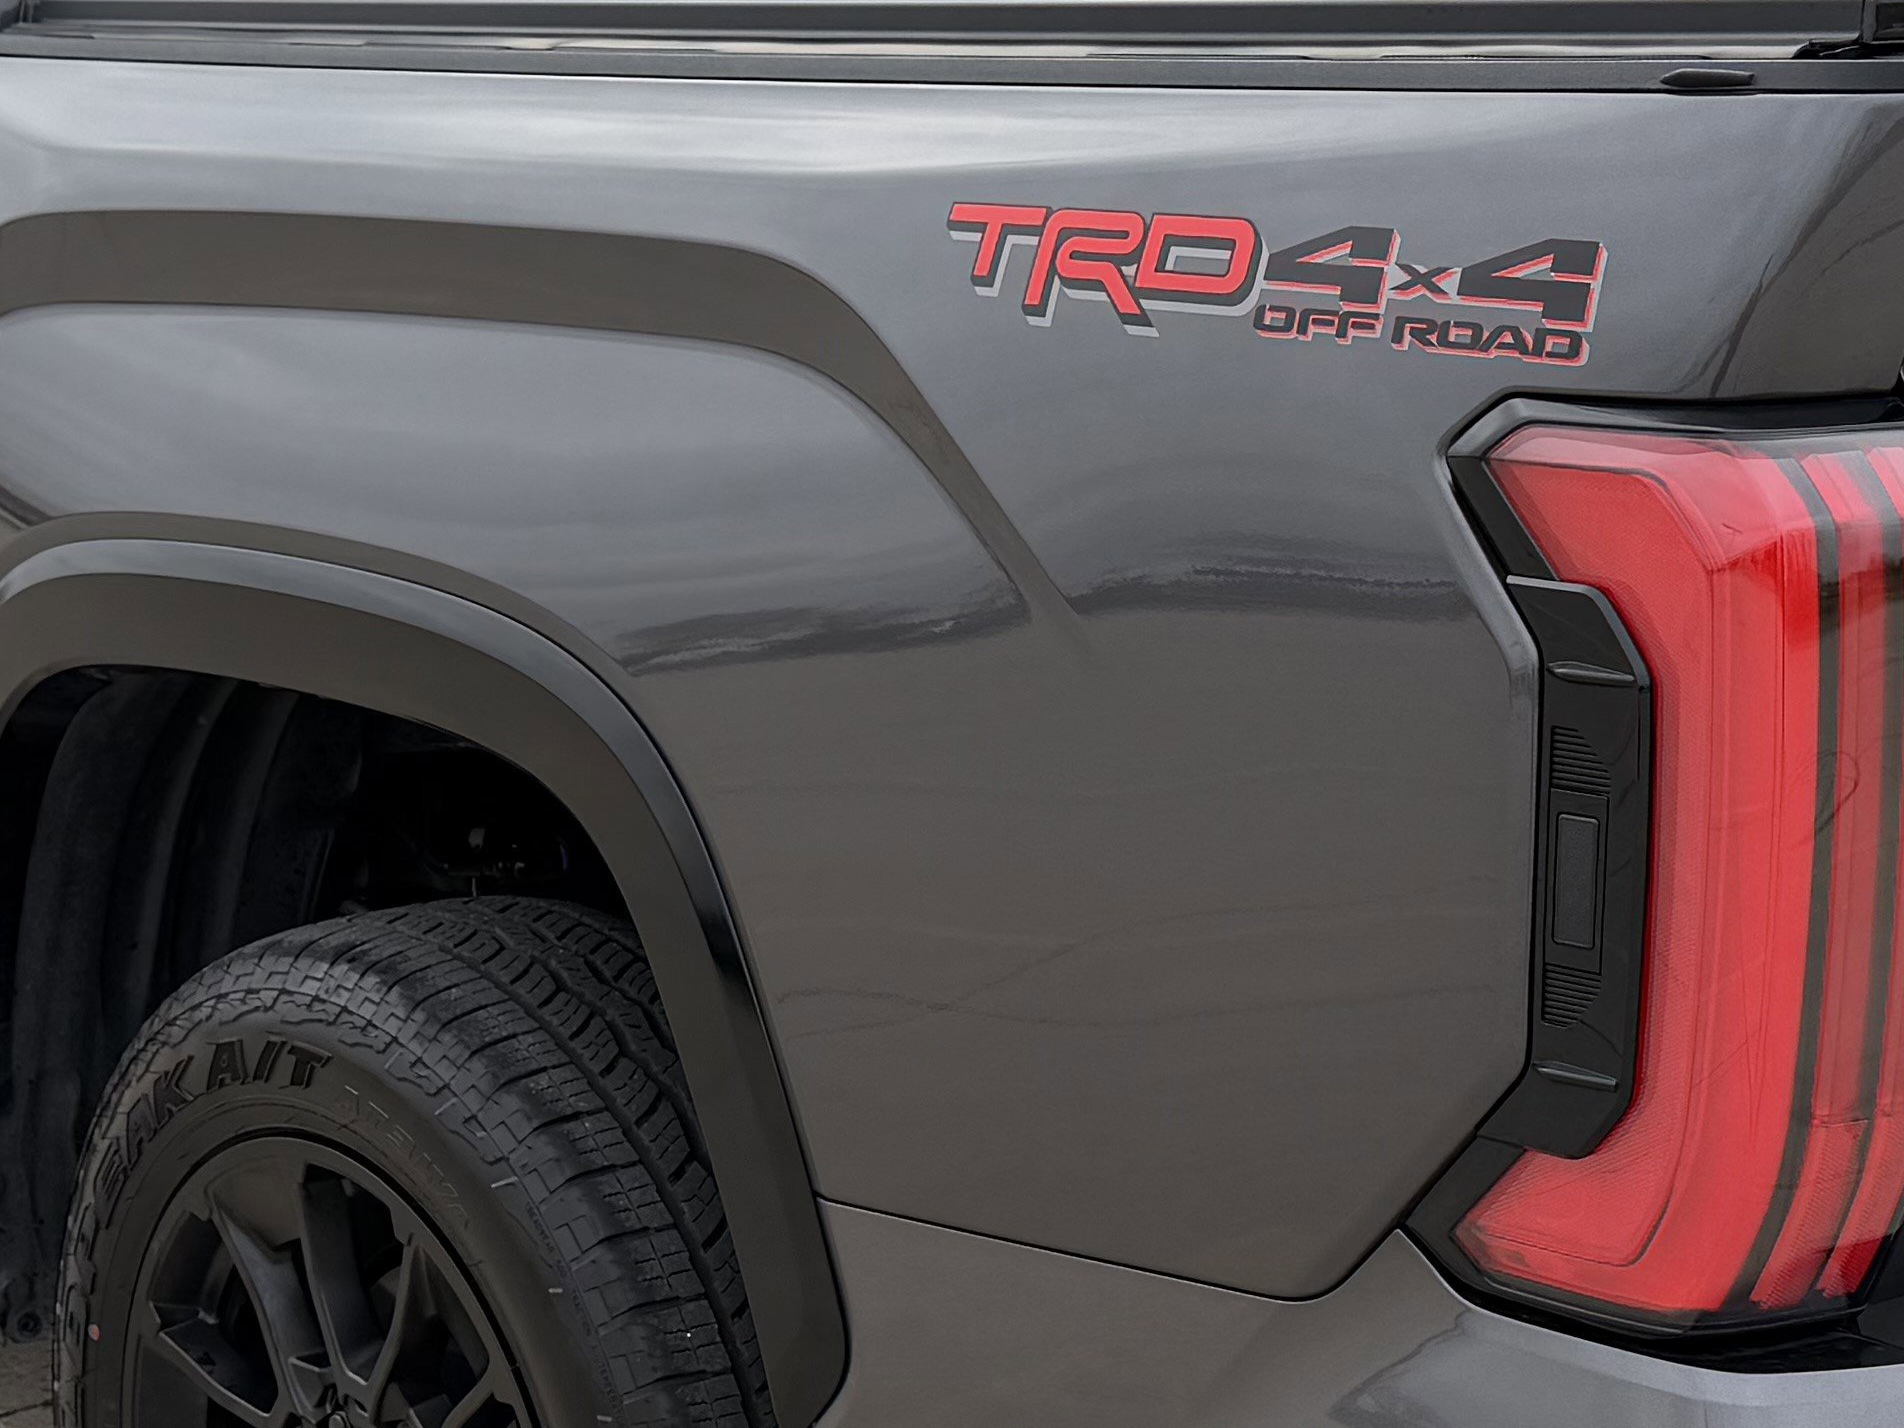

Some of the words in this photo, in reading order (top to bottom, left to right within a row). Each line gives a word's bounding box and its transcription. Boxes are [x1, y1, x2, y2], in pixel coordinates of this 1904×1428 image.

[946, 200, 1268, 339] TRD
[1252, 303, 1384, 345] OFF
[1391, 316, 1591, 367] ROAD
[205, 1032, 333, 1091] A/T
